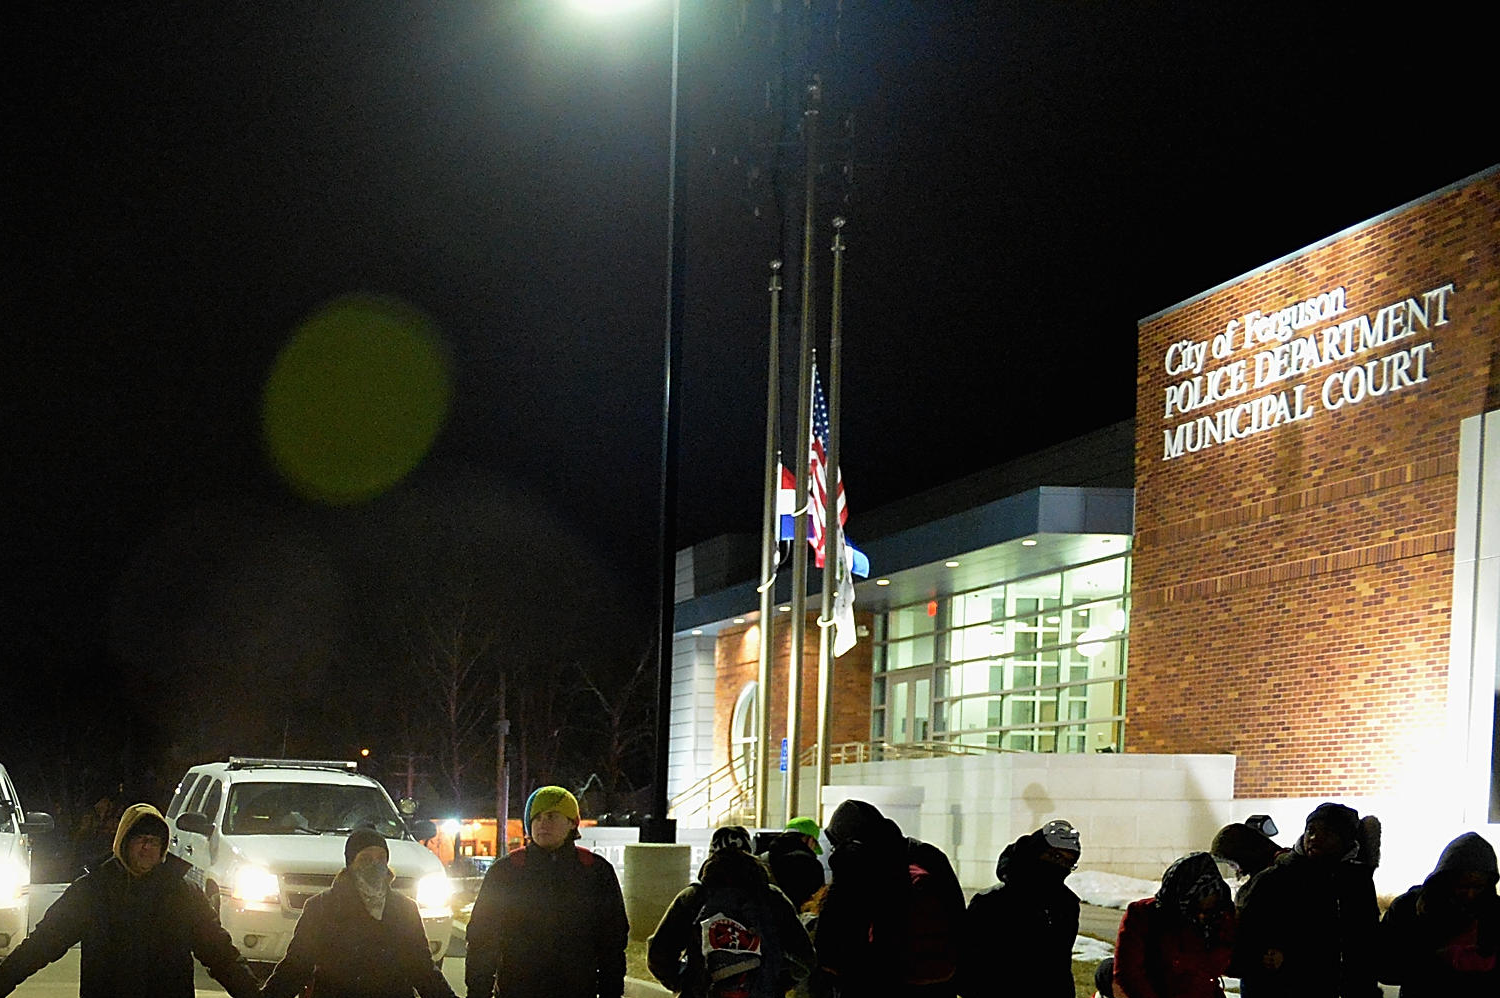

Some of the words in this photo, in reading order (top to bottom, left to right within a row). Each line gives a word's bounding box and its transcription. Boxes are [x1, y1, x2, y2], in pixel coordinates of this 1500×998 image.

[1163, 359, 1248, 419] POLICE
[1254, 282, 1455, 389] DEPARTMENT
[1165, 338, 1207, 376] City
[1212, 318, 1240, 360] of
[1244, 285, 1348, 347] Ferguson
[1162, 385, 1314, 461] MUNICIPAL
[1321, 341, 1435, 411] COURT
